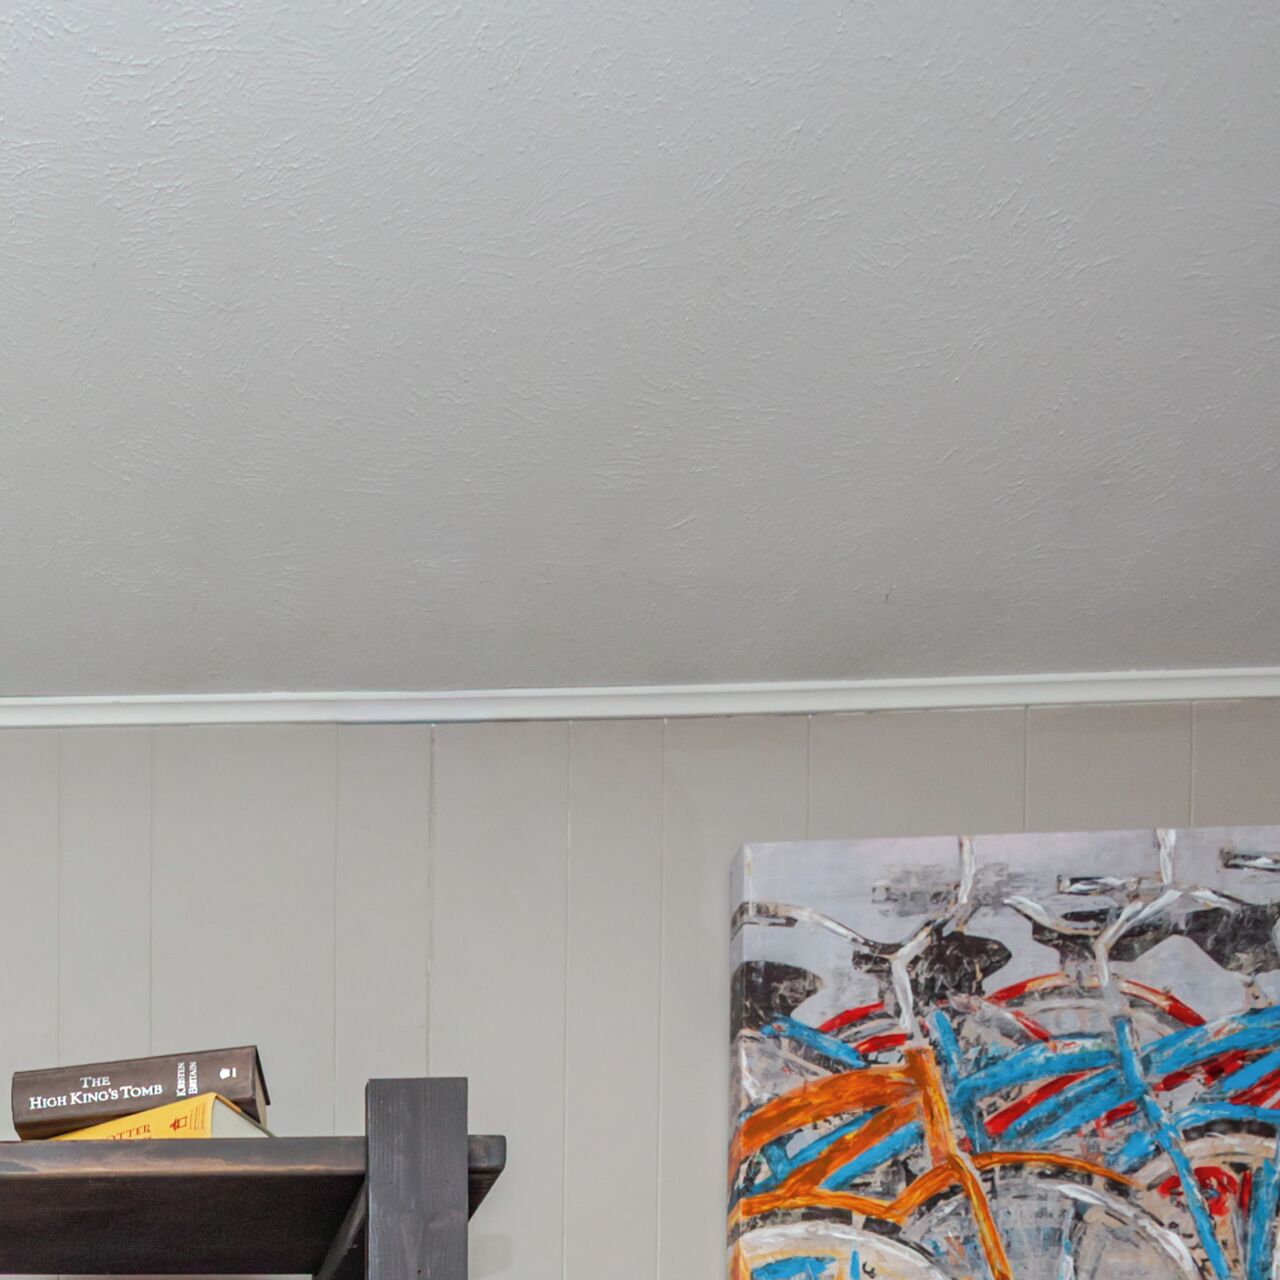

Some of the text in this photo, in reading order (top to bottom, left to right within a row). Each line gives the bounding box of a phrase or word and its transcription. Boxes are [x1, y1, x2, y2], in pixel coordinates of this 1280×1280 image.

[80, 1076, 111, 1088] THE
[29, 1084, 163, 1110] HIGH KING'S TOMB
[107, 1124, 151, 1140] OTTER
